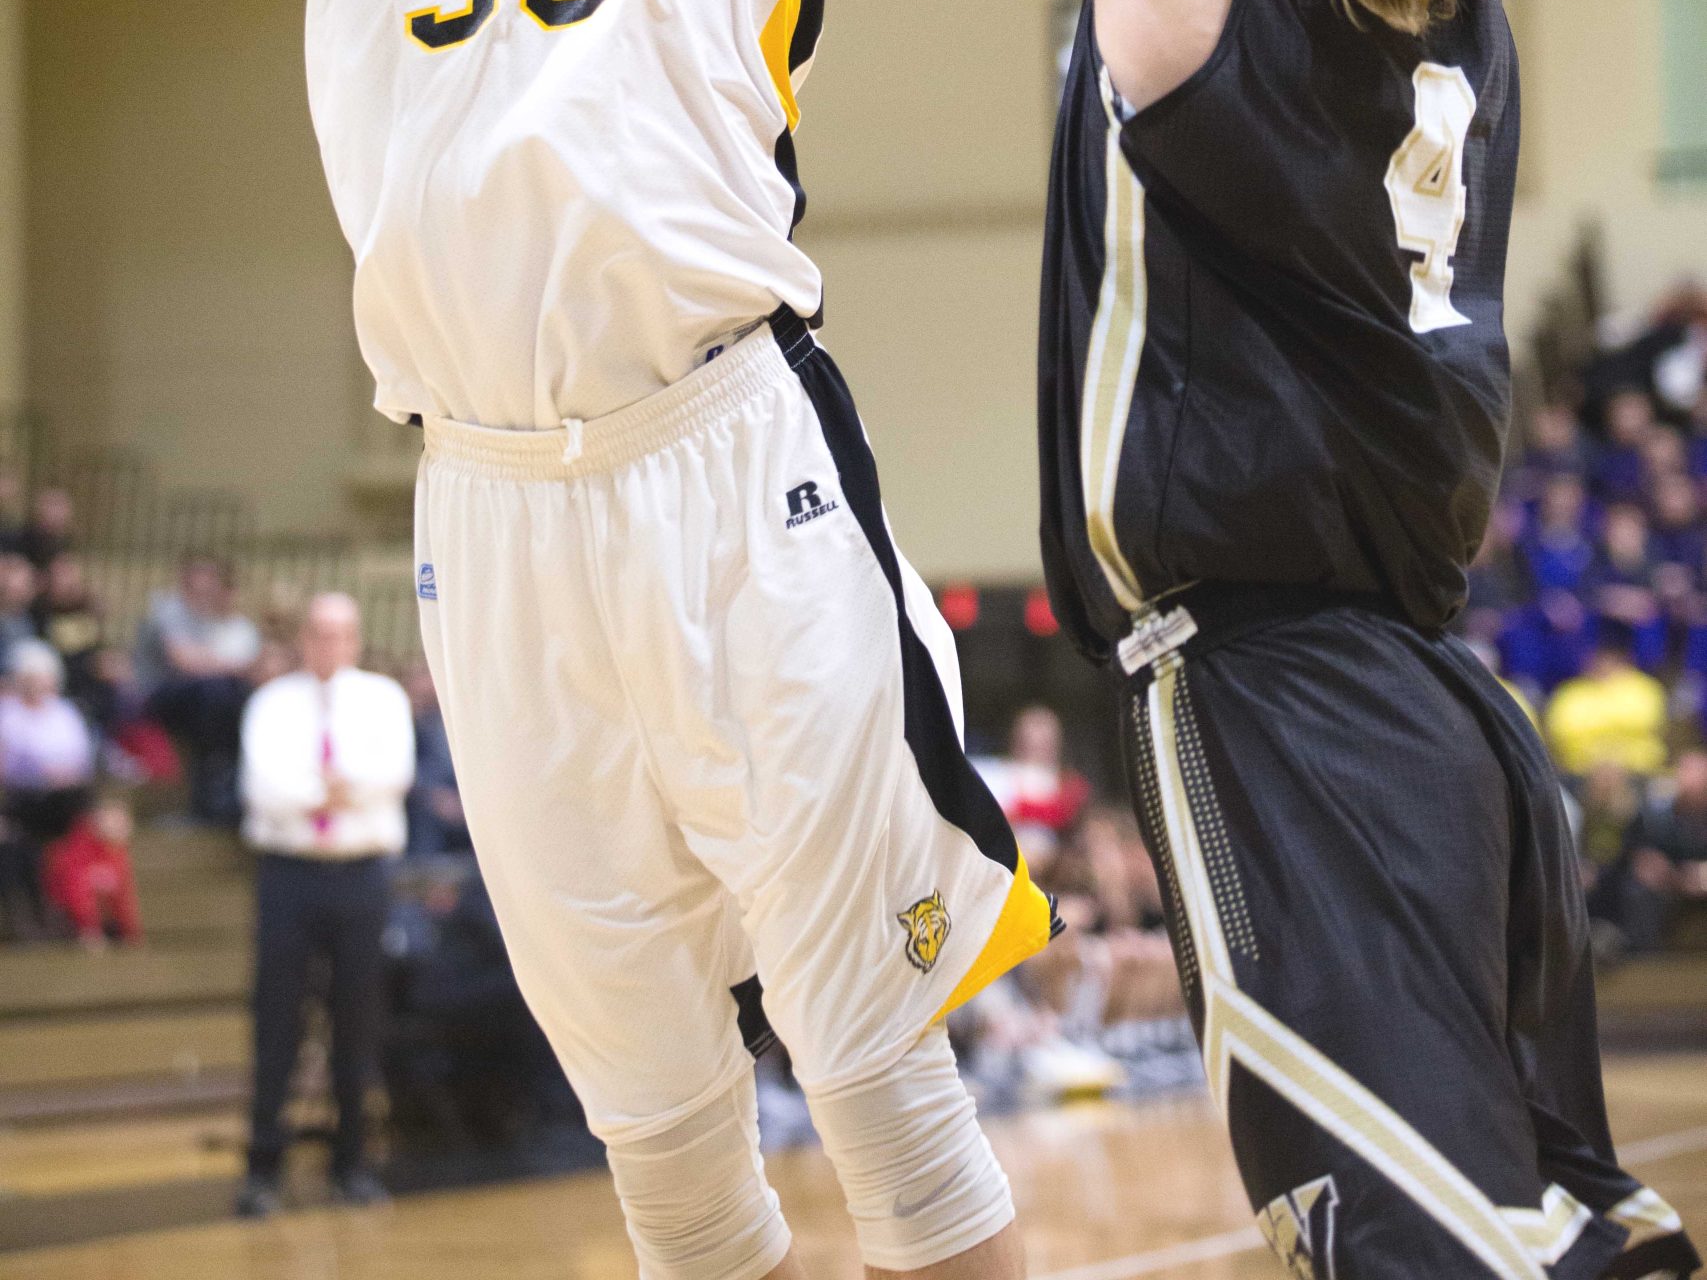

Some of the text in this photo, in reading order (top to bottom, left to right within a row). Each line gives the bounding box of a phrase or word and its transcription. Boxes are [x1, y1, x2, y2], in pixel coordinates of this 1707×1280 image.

[1383, 61, 1477, 334] 4
[785, 480, 821, 517] R
[785, 500, 839, 530] RUSSELL
